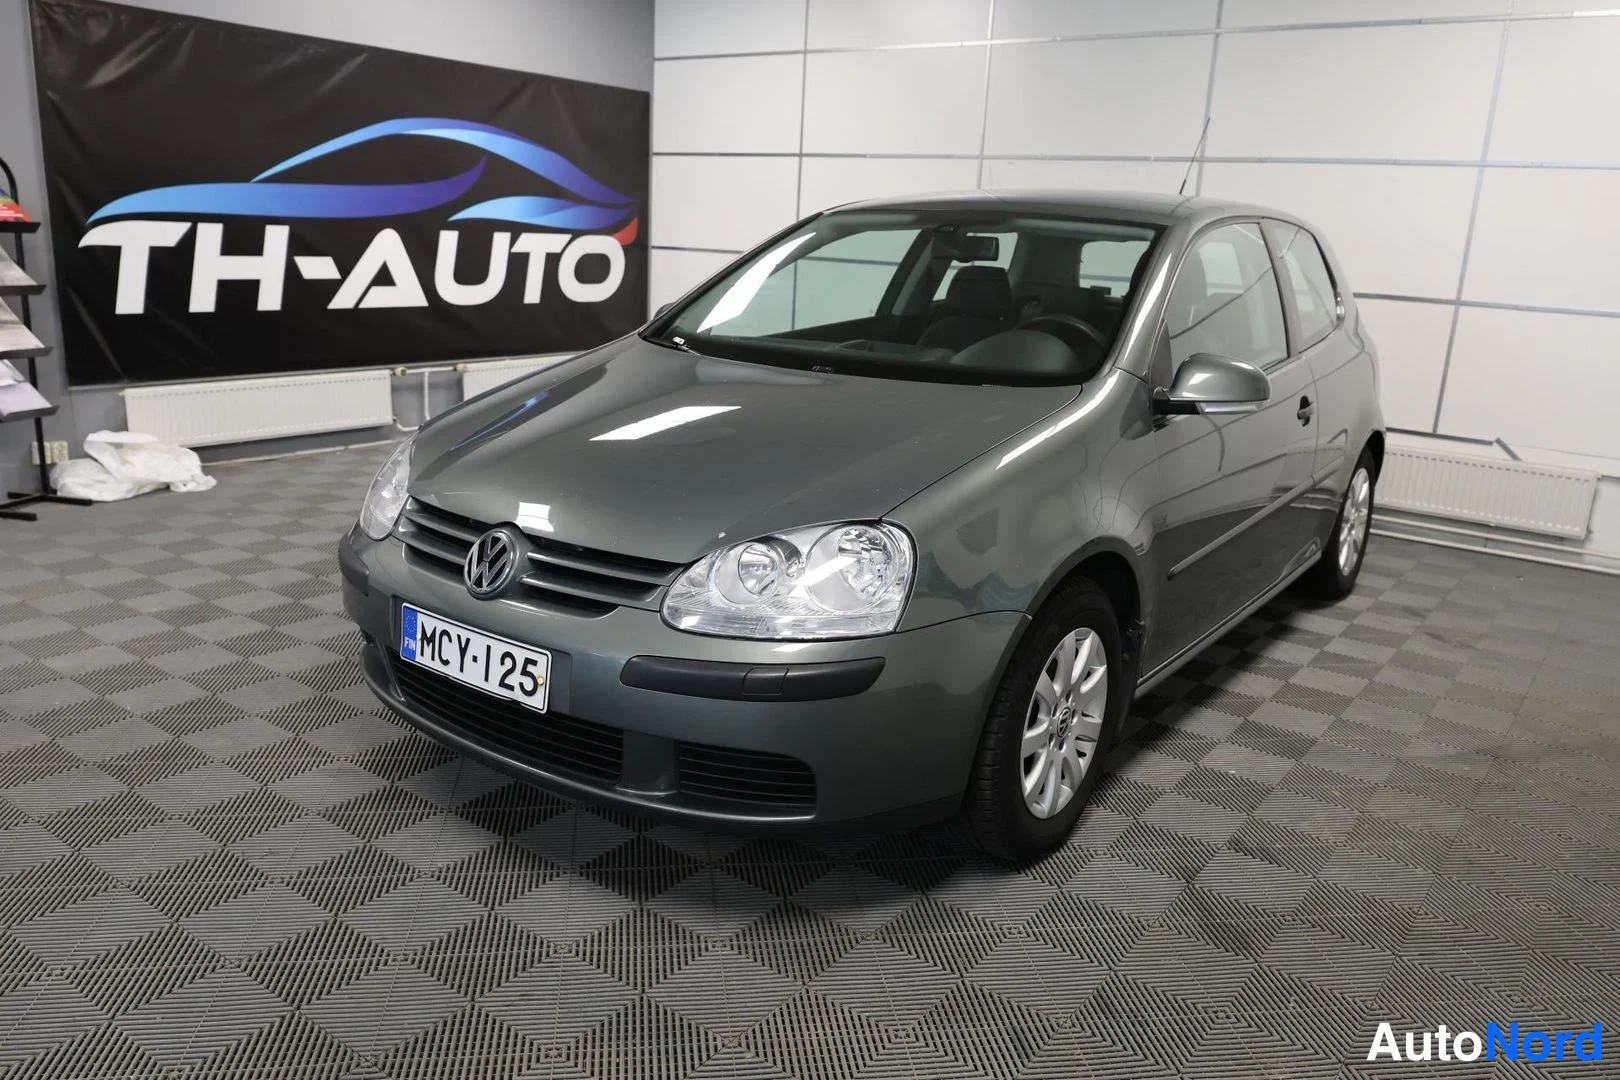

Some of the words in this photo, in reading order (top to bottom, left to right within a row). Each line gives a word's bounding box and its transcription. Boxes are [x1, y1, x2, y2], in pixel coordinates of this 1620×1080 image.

[78, 220, 626, 315] TH-AUTO
[404, 637, 416, 650] FIN
[420, 621, 539, 697] MCY-125
